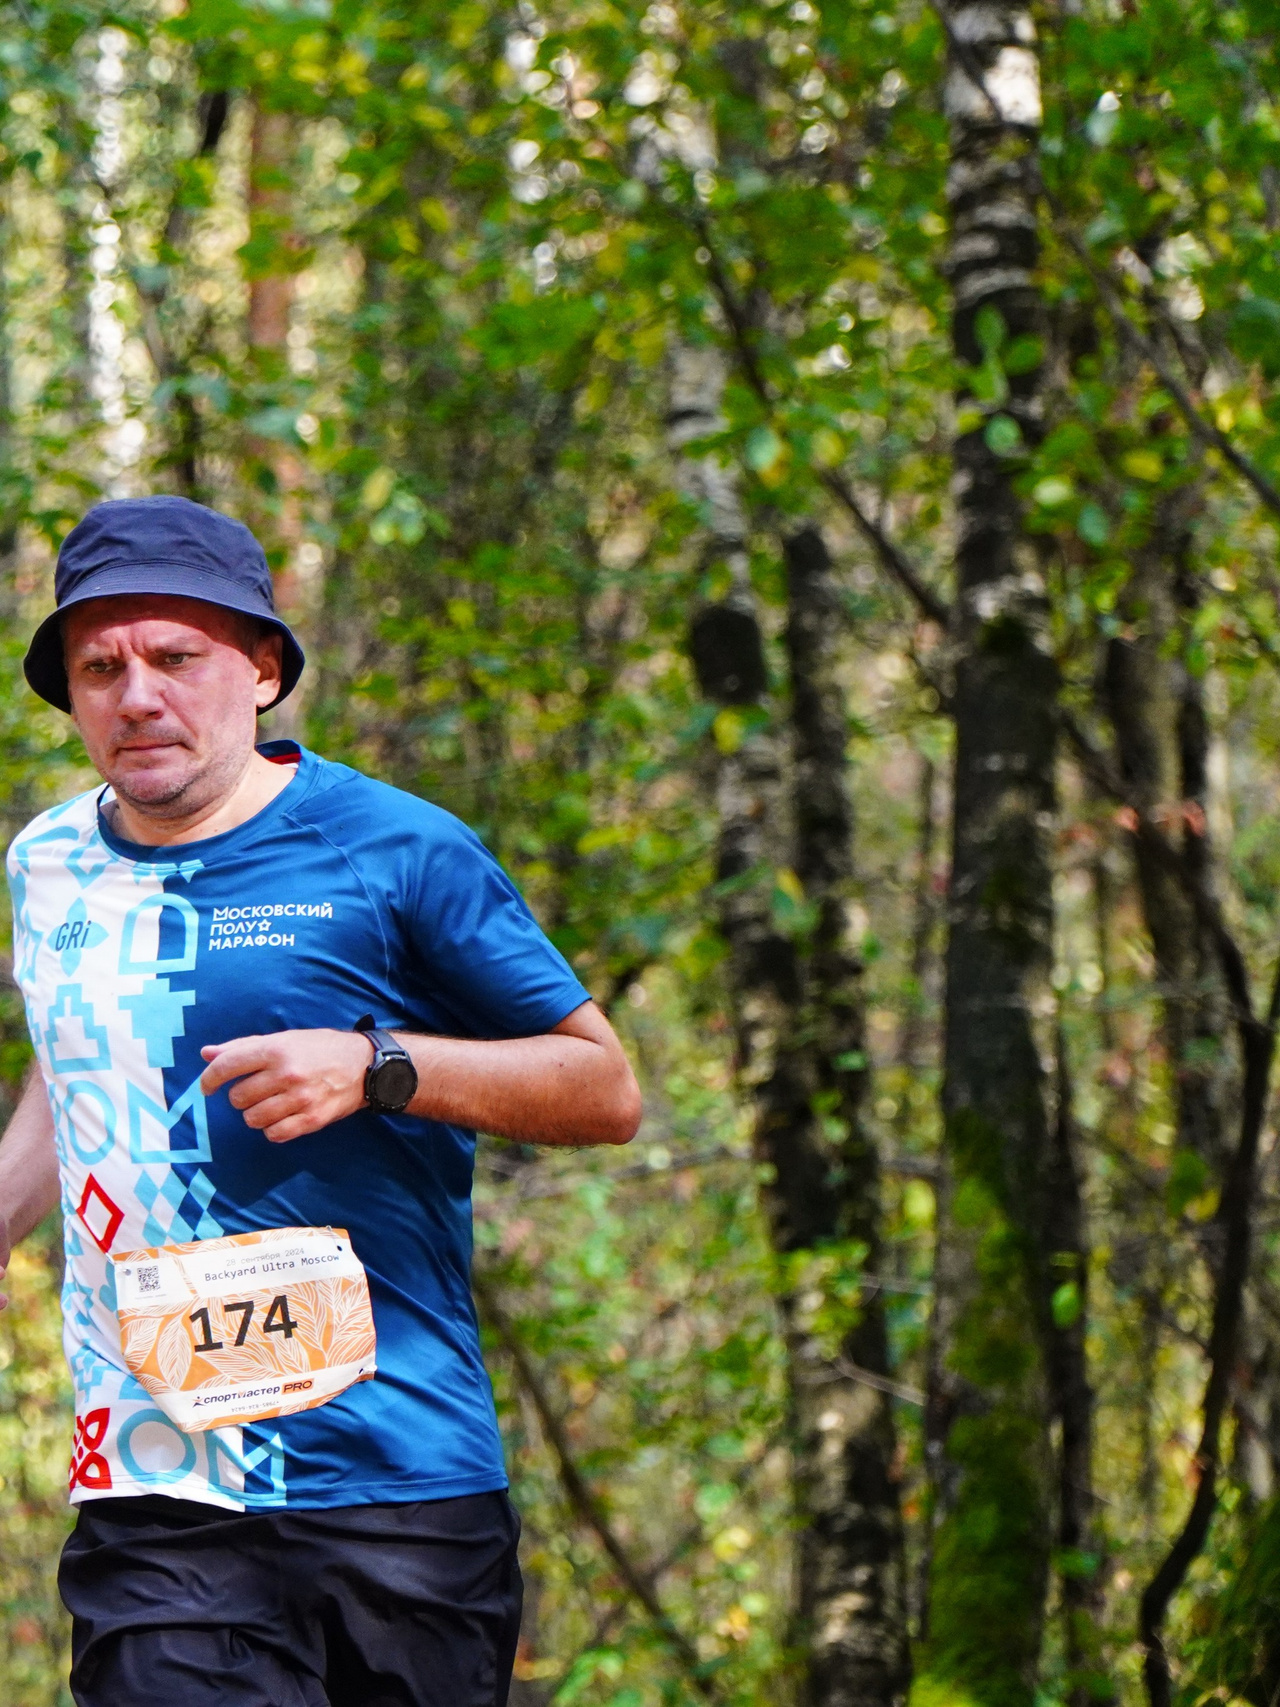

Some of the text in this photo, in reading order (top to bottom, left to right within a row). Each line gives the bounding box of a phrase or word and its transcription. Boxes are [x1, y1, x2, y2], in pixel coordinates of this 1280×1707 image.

[212, 902, 333, 921] МОСКОВСКИЙ
[210, 920, 258, 936] ПОЛУ
[208, 933, 295, 951] МАРАФОН
[225, 1247, 305, 1267] 28 сентября 2024
[204, 1254, 340, 1282] Backyard Ultra Moscow
[189, 1294, 298, 1353] 174
[283, 1380, 313, 1394] PRO
